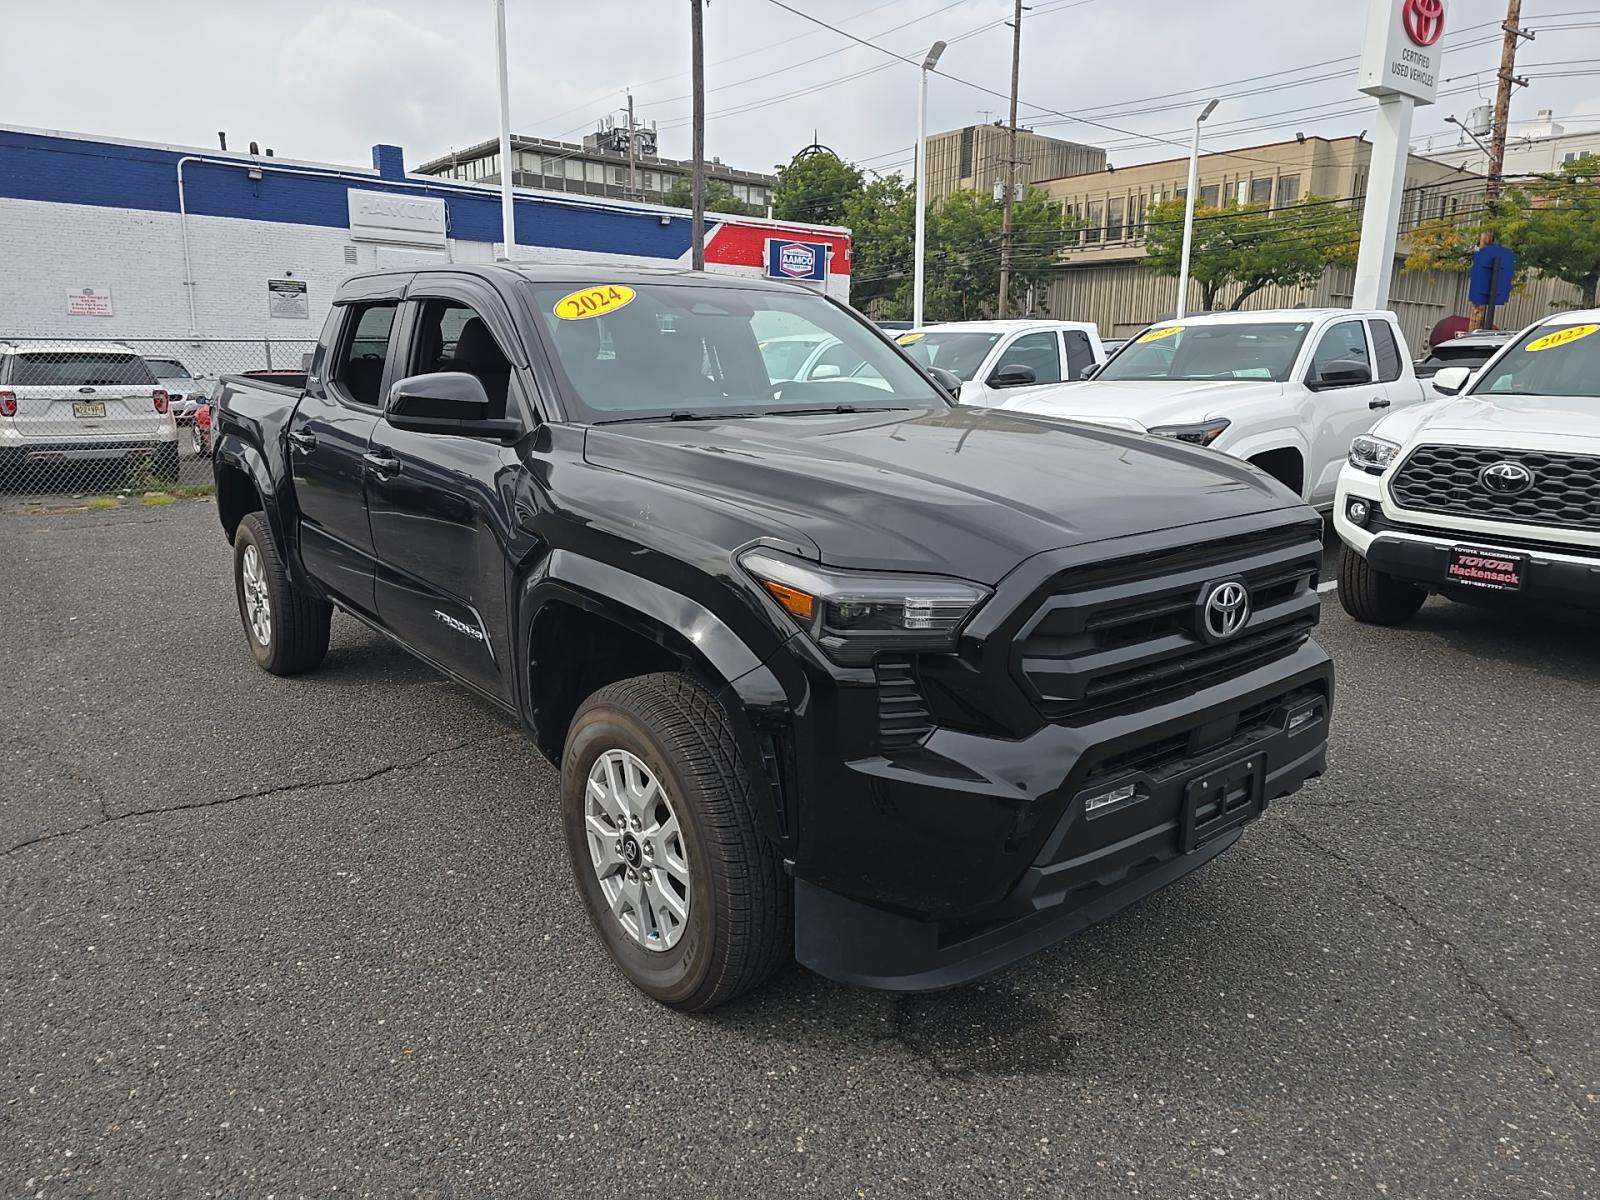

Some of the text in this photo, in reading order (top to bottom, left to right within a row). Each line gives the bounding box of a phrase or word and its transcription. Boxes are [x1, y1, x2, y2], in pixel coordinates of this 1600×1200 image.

[1402, 48, 1430, 68] CERTIFIED
[1391, 61, 1434, 87] USED VEHICLES
[782, 254, 813, 266] AAMCO
[567, 286, 622, 317] 2024
[1540, 327, 1585, 348] 2022
[1454, 547, 1478, 555] TOYOTA
[1458, 555, 1513, 572] TOYOTA
[1449, 564, 1519, 584] Hackensack
